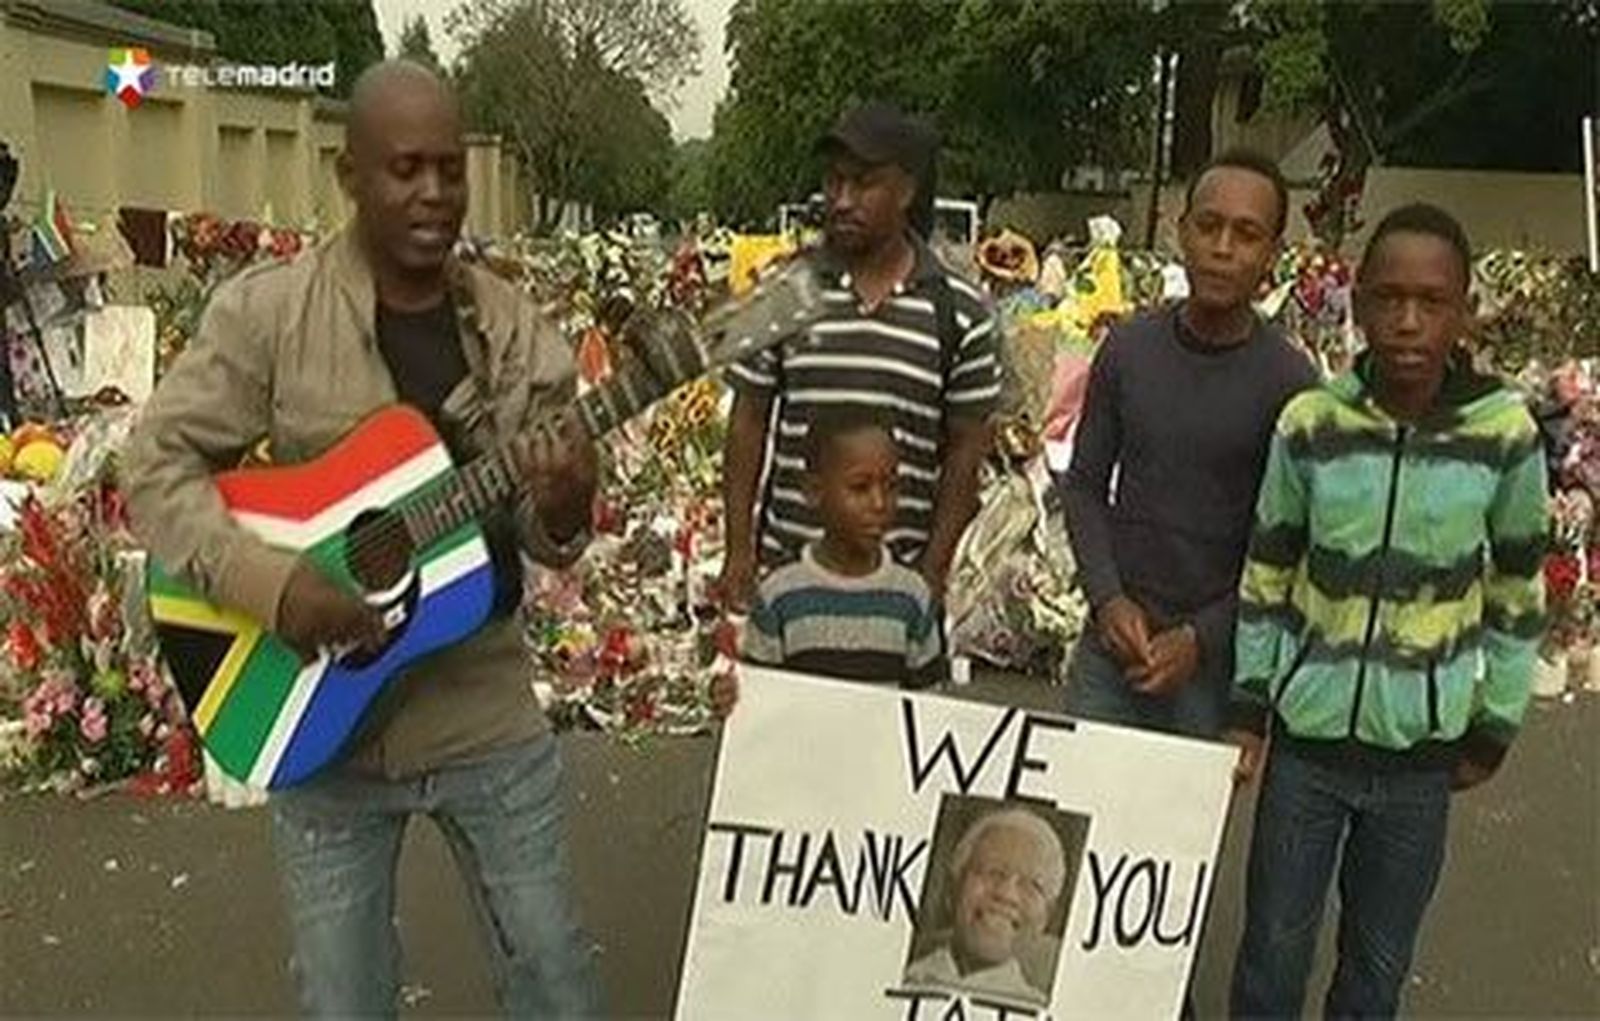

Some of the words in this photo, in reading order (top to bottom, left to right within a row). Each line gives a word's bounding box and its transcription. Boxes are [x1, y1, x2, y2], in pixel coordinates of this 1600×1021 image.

[902, 699, 1076, 808] WE
[709, 823, 927, 929] THANK
[1081, 851, 1207, 950] YOU
[884, 989, 1054, 1021] TT
